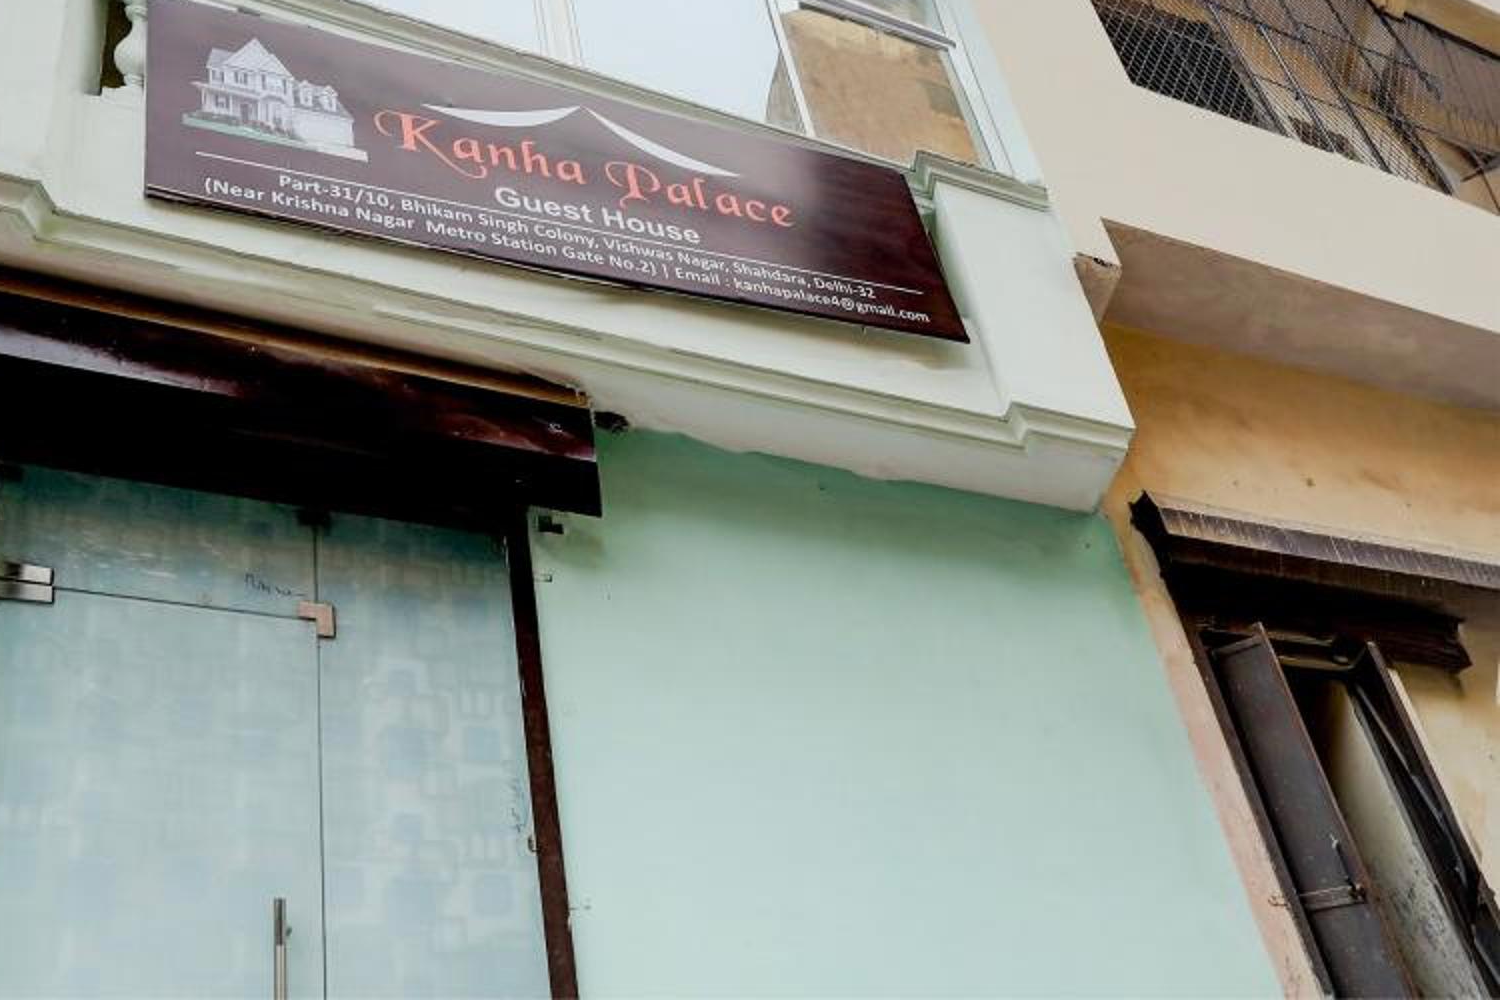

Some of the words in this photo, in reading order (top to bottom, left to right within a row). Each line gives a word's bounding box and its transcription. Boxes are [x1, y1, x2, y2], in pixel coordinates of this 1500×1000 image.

[373, 108, 587, 185] Kanha
[605, 160, 795, 227] Palace
[494, 186, 594, 224] Guest
[601, 207, 701, 244] House
[204, 177, 265, 201] (Near
[271, 191, 350, 218] Krishna
[355, 207, 415, 230] Nagar
[425, 220, 486, 243] Metro
[491, 232, 558, 256] Station
[562, 245, 604, 266] Gate
[609, 255, 658, 277] No.2)
[674, 266, 721, 286] Email
[279, 175, 395, 210] Part-31/10,
[401, 199, 473, 224] Bhikam
[478, 213, 529, 235] Singh
[533, 223, 599, 249] Colony,
[604, 237, 673, 262] Vishwas
[678, 251, 730, 272] Nagar,
[733, 263, 812, 289] Shahdara,
[814, 277, 877, 299] Delhi-32
